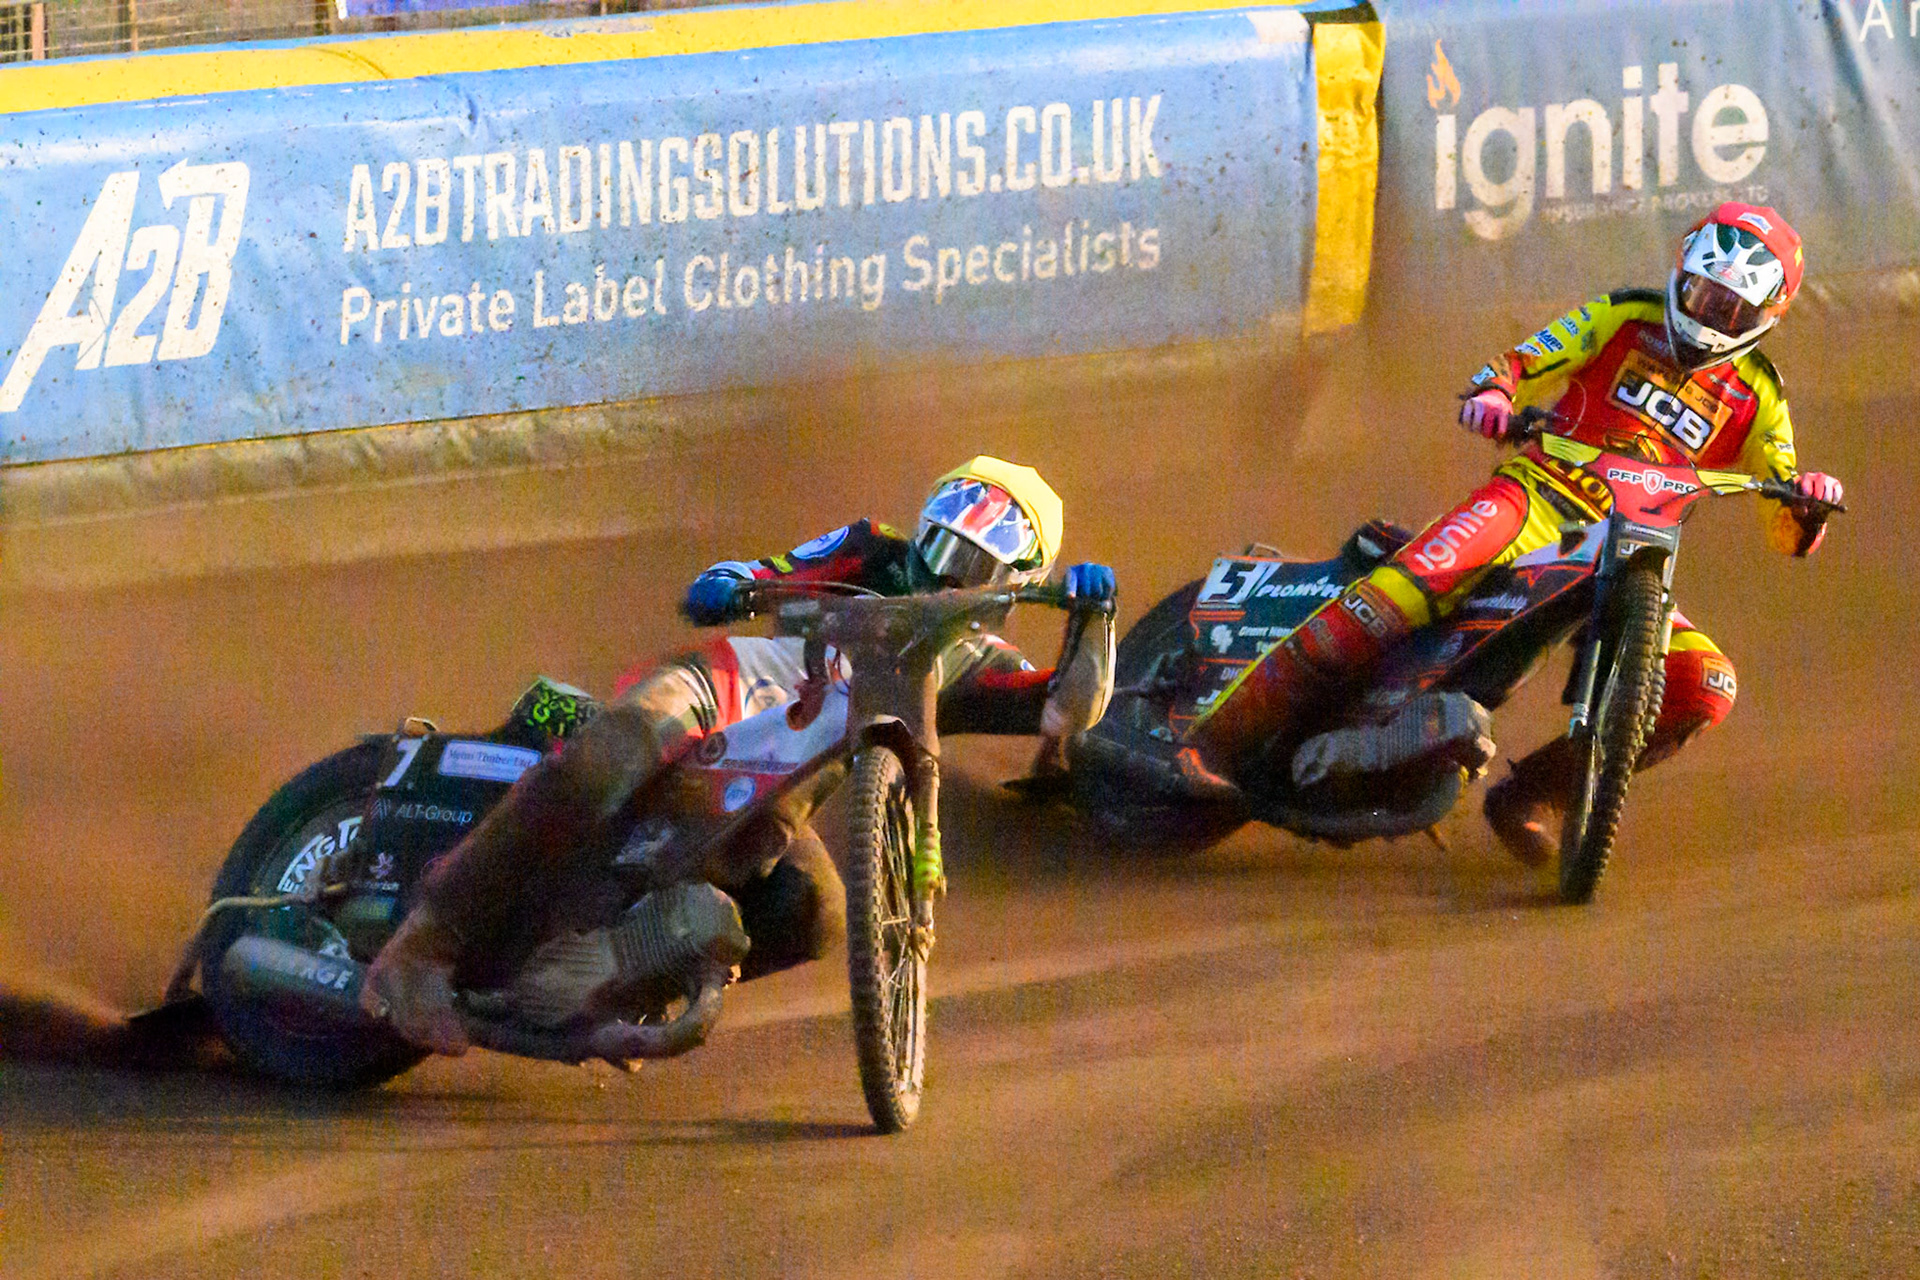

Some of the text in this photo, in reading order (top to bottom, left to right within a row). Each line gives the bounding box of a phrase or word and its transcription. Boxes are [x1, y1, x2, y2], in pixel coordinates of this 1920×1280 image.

[343, 94, 1162, 254] A2BTRADINGSOLUTIONS.CO.UK
[1434, 62, 1770, 241] ignite
[0, 158, 251, 413] A2B
[340, 219, 1161, 346] Private Label Clothing Specialists
[1607, 469, 1698, 494] PFP PRO
[1616, 381, 1711, 450] JCB
